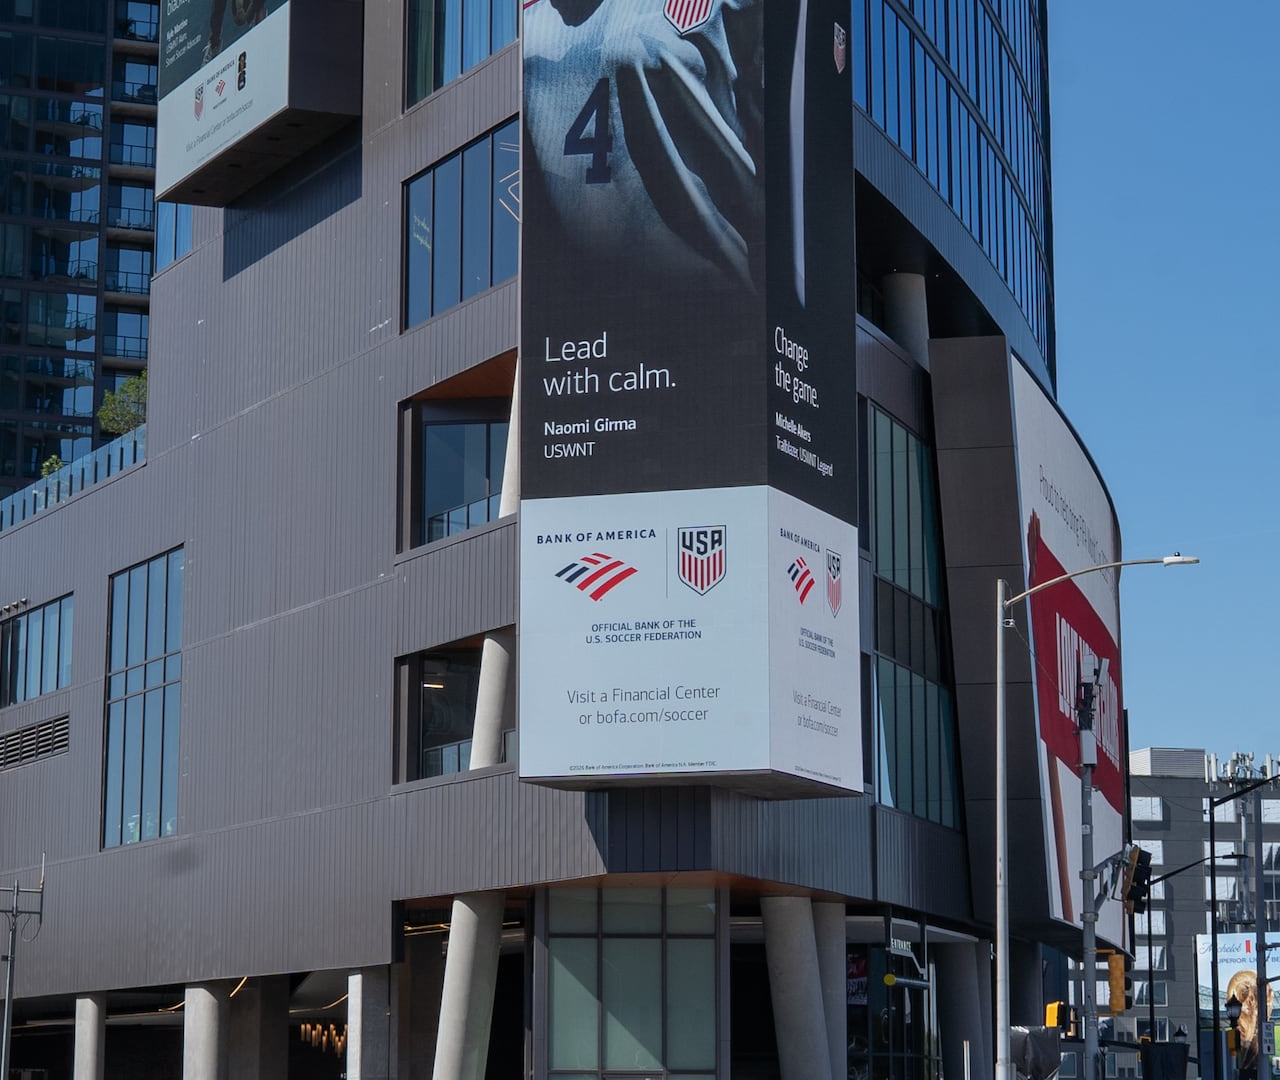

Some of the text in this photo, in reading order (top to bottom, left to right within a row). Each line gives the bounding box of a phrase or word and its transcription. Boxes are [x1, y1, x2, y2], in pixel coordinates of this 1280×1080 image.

[563, 77, 613, 184] 4
[545, 331, 608, 362] Lead
[774, 326, 809, 372] Change
[543, 363, 677, 396] with calm.
[775, 361, 820, 409] the game.
[544, 417, 637, 436] Naomi Girma
[775, 411, 798, 435] Michelle
[544, 441, 596, 459] USWNT
[536, 528, 657, 545] BANK OF AMERICA
[681, 529, 723, 556] USA
[780, 527, 794, 541] BANK
[800, 536, 821, 553] AMERICA
[585, 630, 702, 644] U.S. SOCCER FEDERATION
[591, 618, 697, 633] OFFICIAL BANK OF THE
[567, 685, 721, 704] Visit a Financial Center
[579, 708, 709, 725] or bofa.com/soccer
